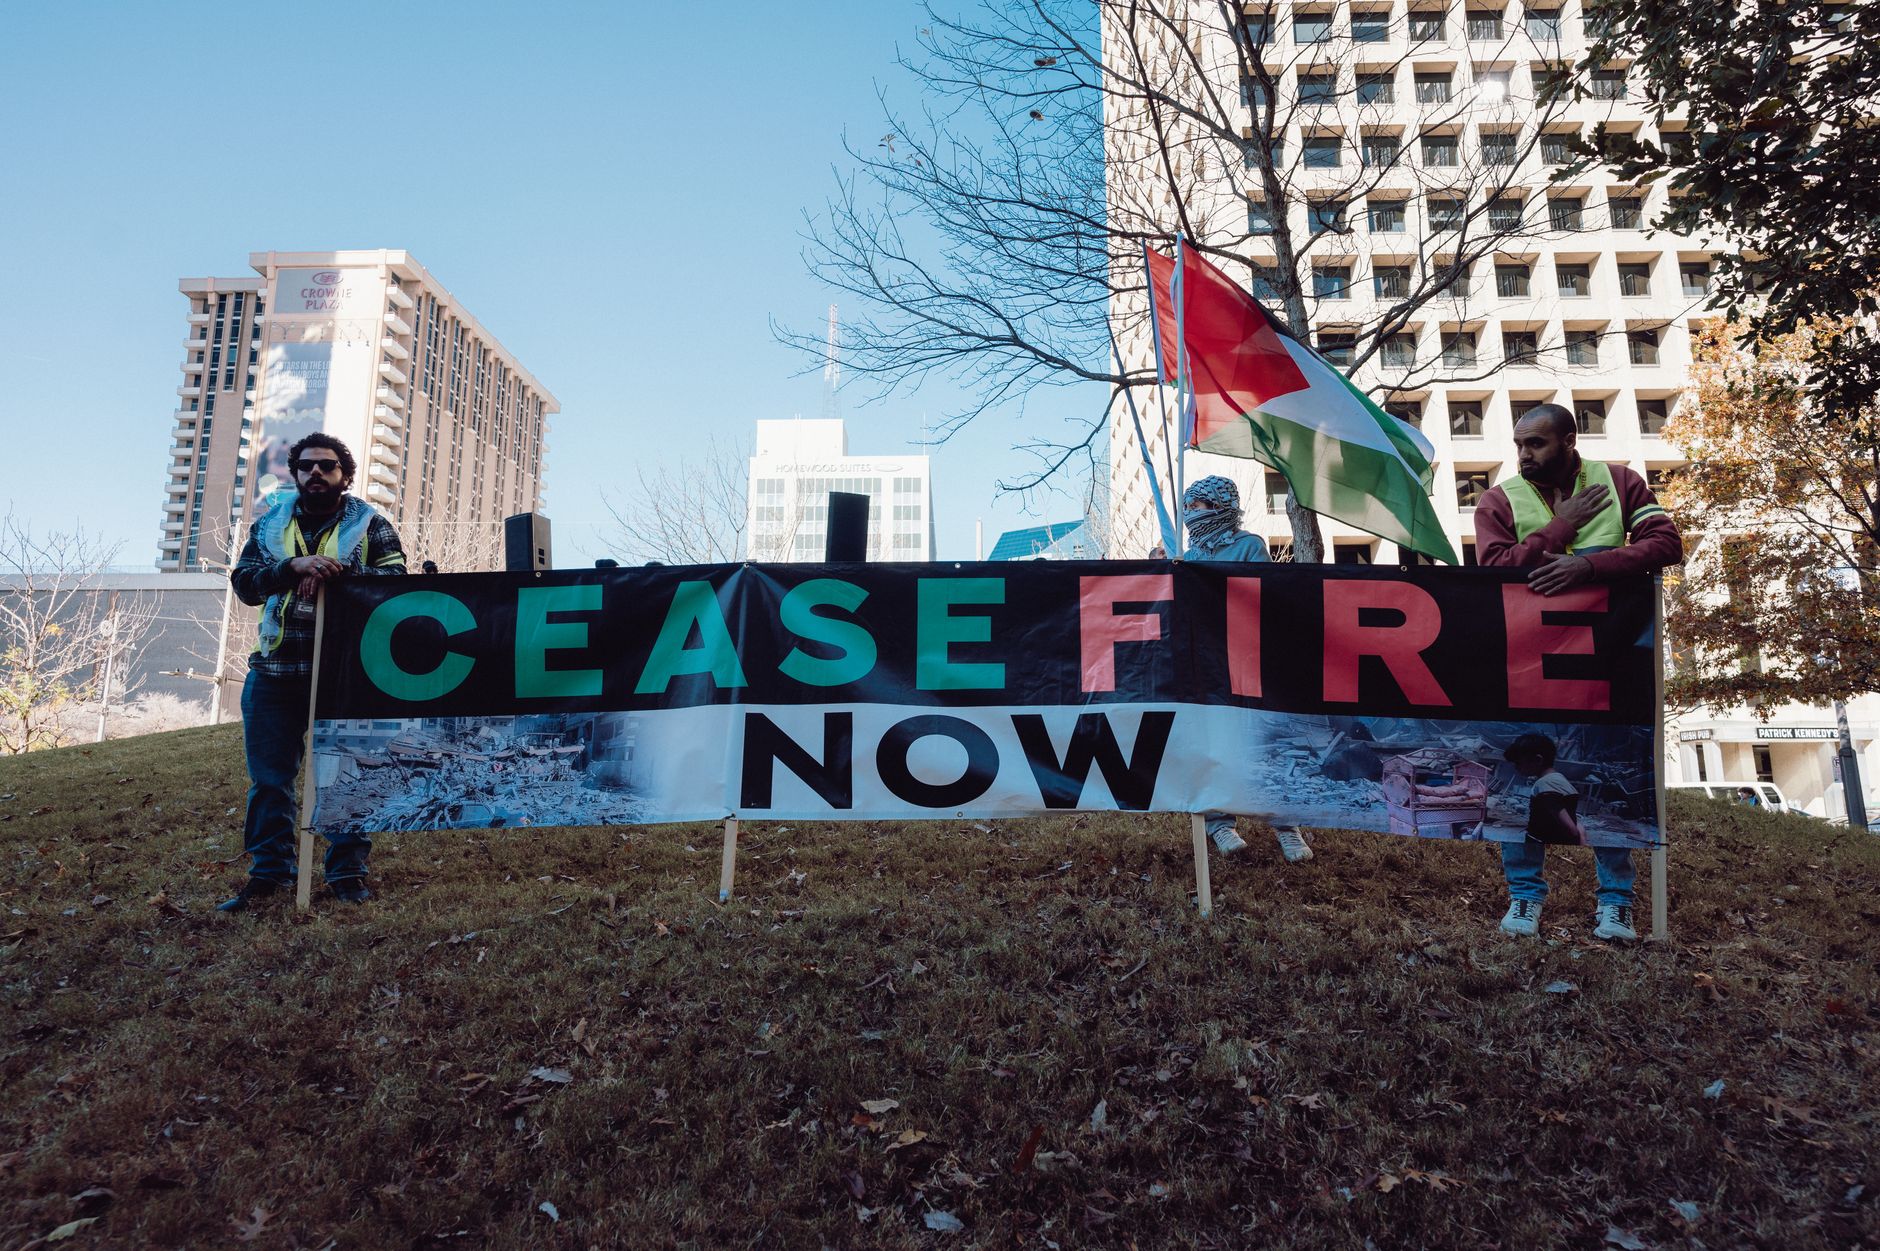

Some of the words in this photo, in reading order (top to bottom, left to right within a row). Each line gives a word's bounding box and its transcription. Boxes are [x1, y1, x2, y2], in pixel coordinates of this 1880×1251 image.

[301, 288, 352, 299] CROWNE
[305, 299, 344, 310] PLAZA
[301, 361, 309, 370] IN
[310, 361, 322, 370] THE
[776, 463, 837, 473] HOMEWOOD
[840, 463, 872, 473] SUITES
[1680, 731, 1697, 741] IRISH
[1698, 730, 1710, 740] PUB
[1759, 728, 1793, 738] PATRICK
[1795, 728, 1839, 738] KENNEDY'S
[740, 711, 1176, 811] NOW
